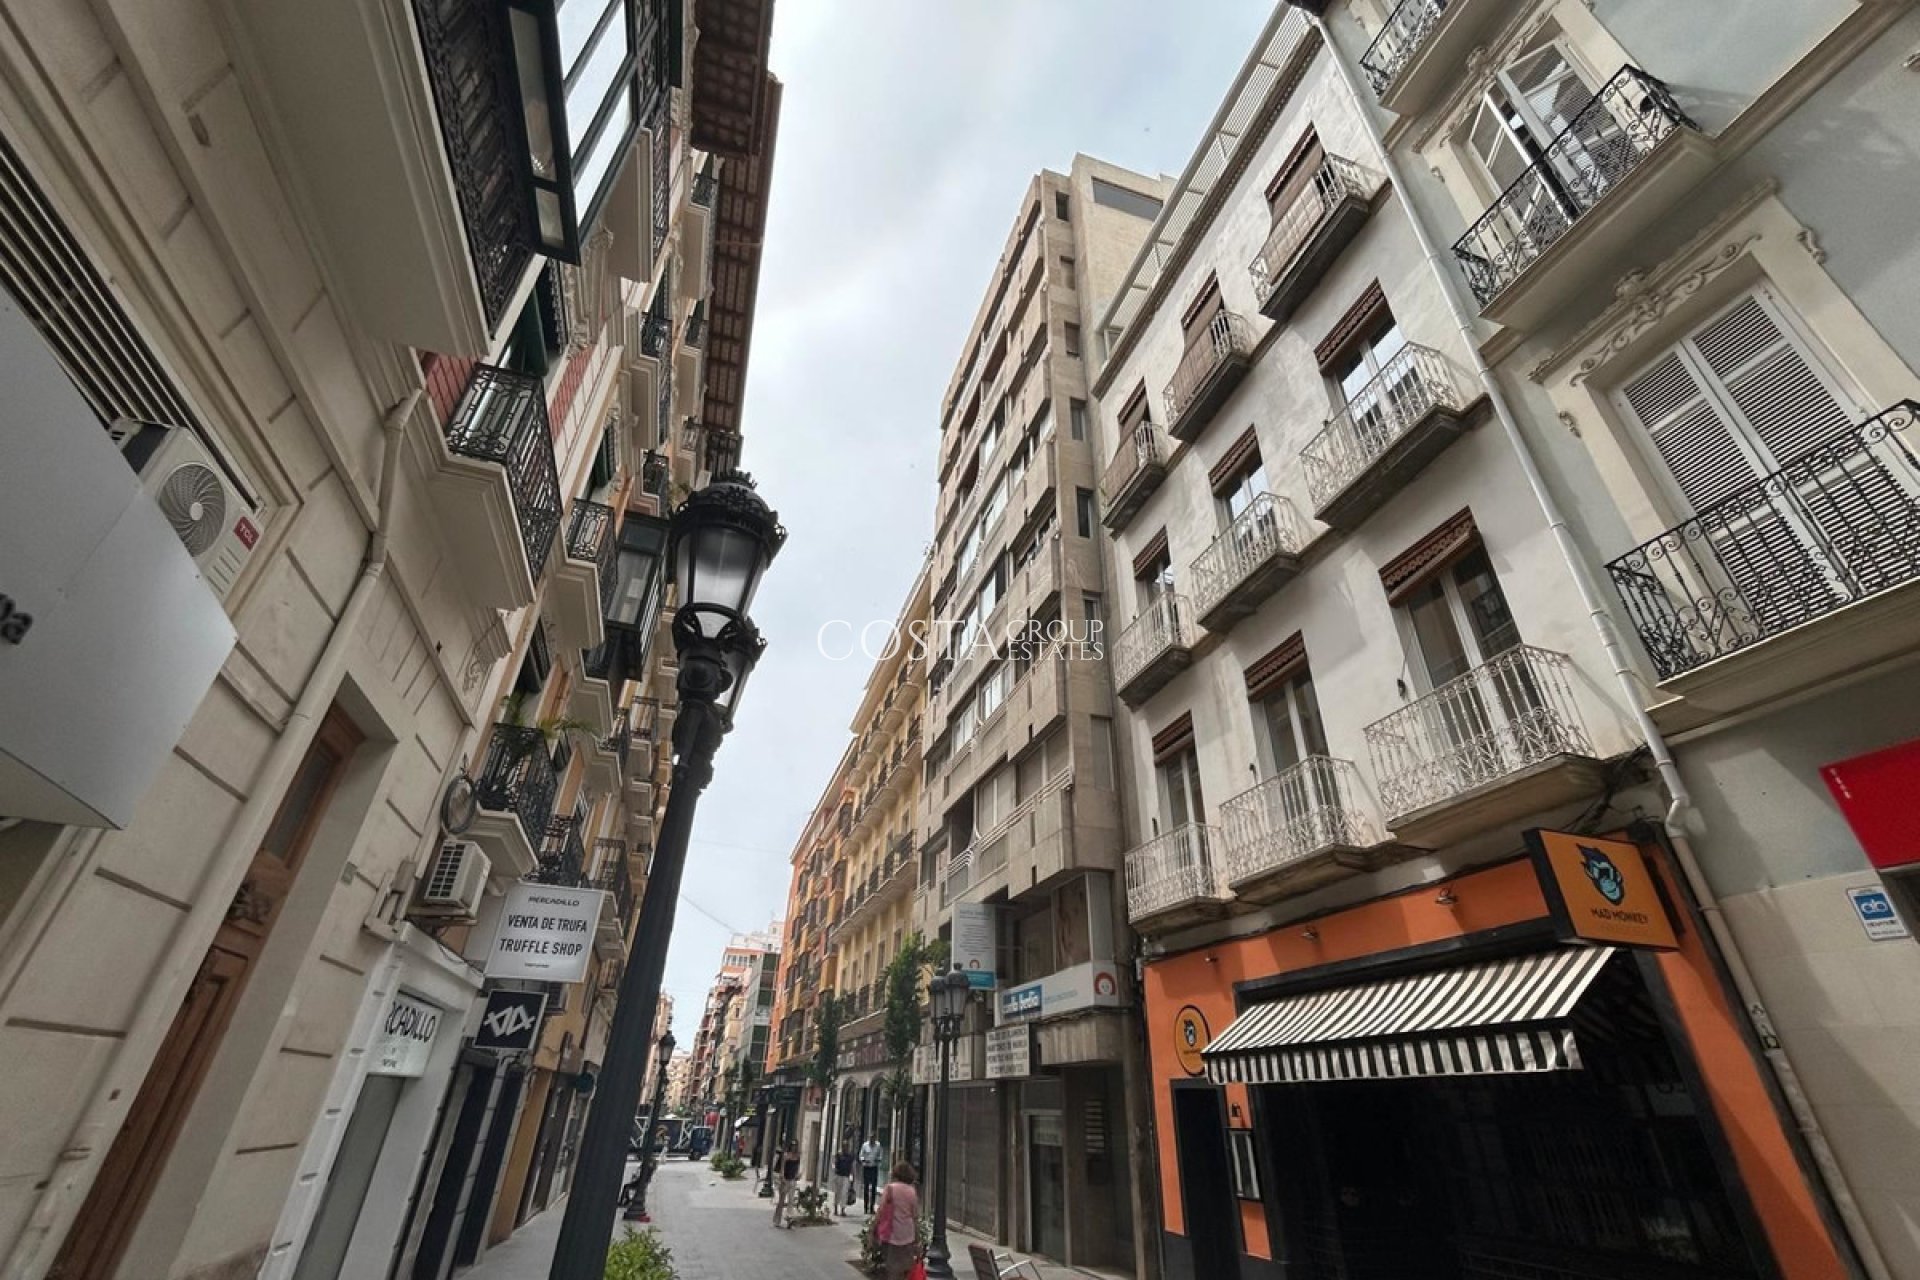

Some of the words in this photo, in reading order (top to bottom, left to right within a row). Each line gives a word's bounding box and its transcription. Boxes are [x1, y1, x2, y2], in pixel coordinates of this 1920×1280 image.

[528, 895, 580, 907] MERCADILLO
[508, 914, 538, 929] VENTA
[540, 916, 555, 930] DE
[557, 918, 587, 933] TRUFA
[1590, 907, 1611, 920] MAD
[1612, 910, 1649, 924] MONKEY
[499, 938, 550, 954] TRUFFLE
[551, 941, 583, 956] SHOP
